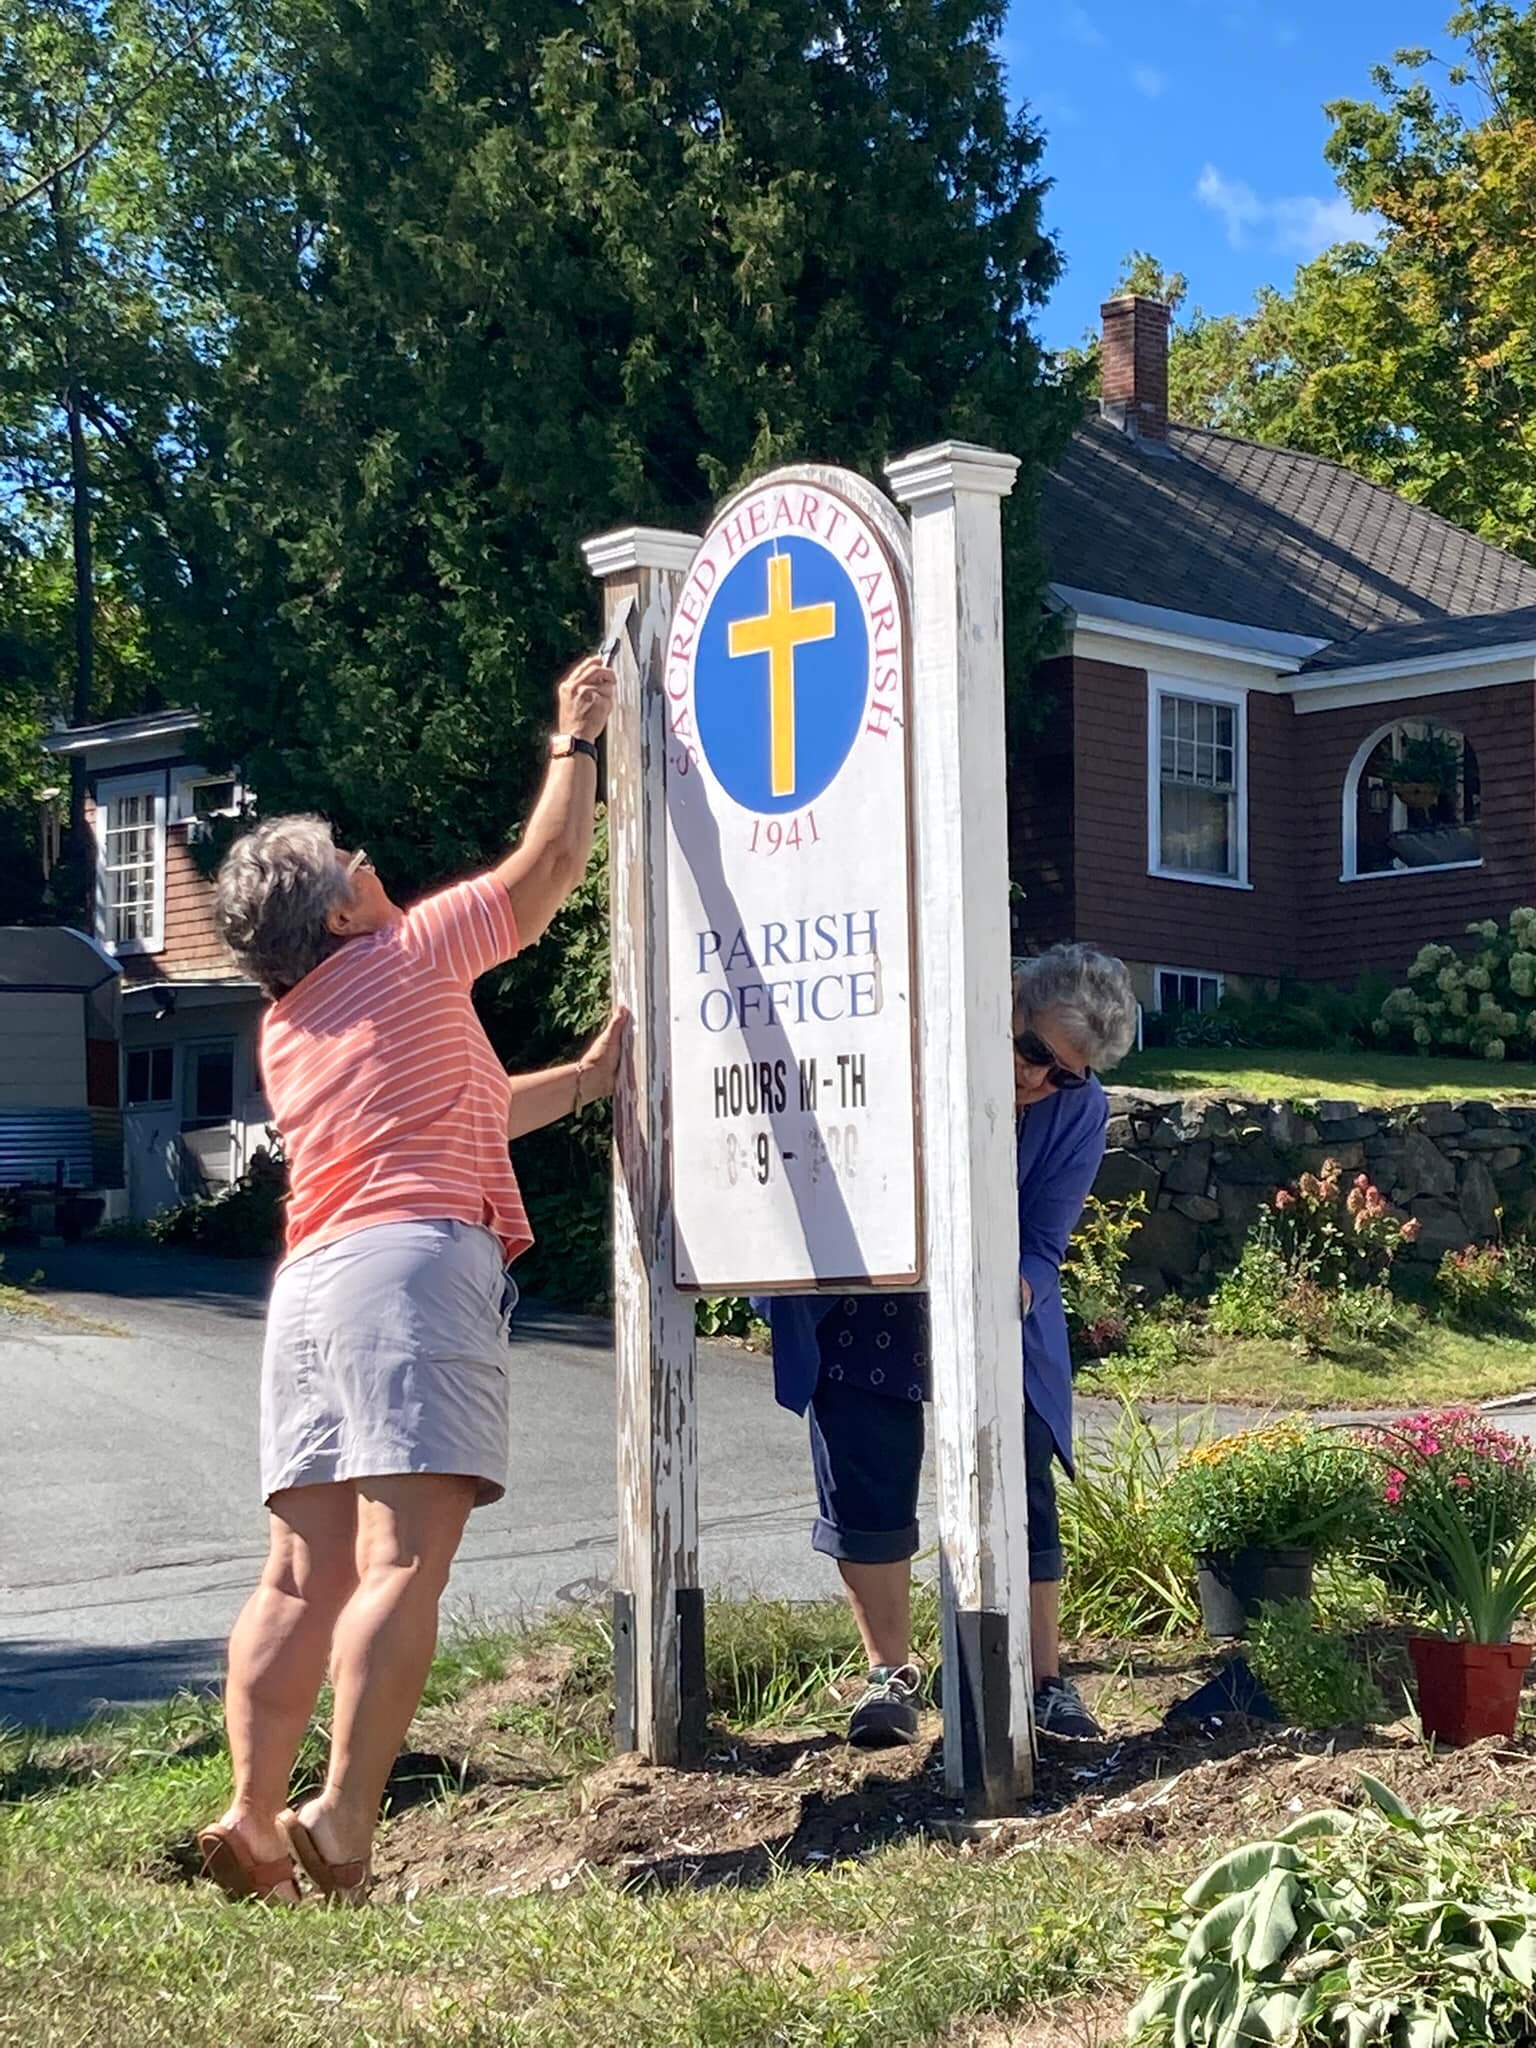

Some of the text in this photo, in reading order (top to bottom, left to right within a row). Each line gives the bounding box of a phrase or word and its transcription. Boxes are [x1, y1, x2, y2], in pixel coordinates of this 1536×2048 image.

[666, 493, 900, 776] SACRED HEART PARISH
[748, 810, 821, 856] 1941
[696, 909, 880, 975] PARISH
[700, 971, 878, 1033] OFFICE
[714, 1059, 787, 1118] HOURS
